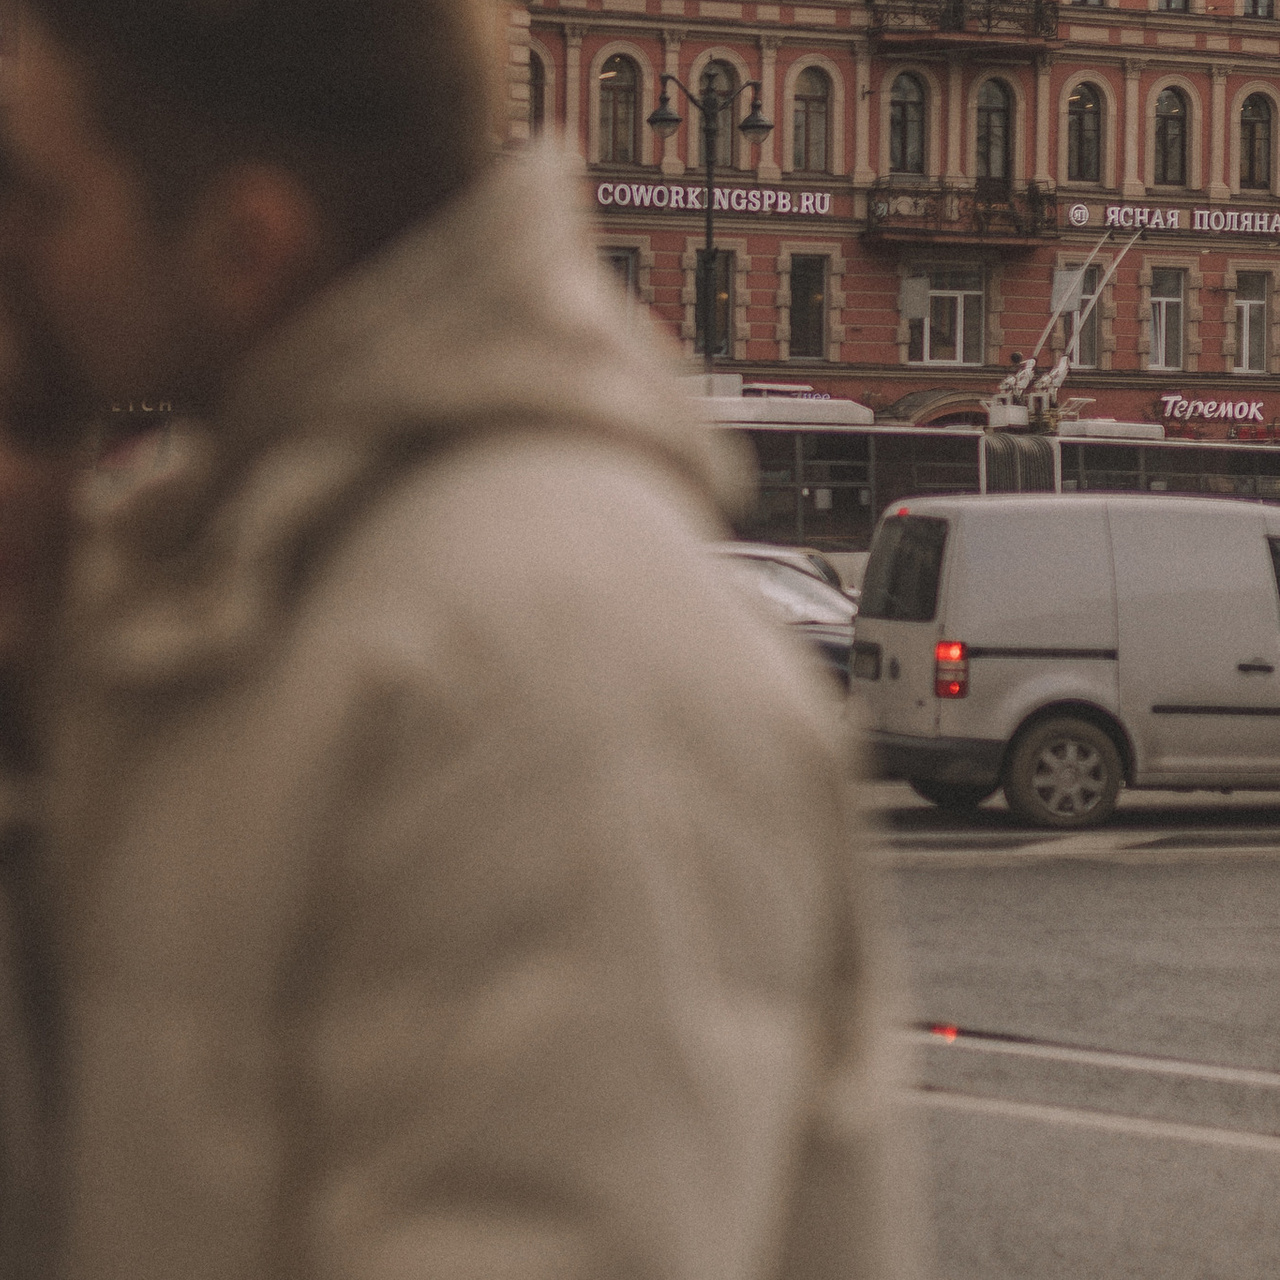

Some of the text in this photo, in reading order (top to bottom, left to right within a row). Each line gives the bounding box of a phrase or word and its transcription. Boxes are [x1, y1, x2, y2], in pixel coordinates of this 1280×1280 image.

[597, 183, 831, 215] COWORKINGSPB.RU
[1105, 206, 1180, 229] ЯСНАЯ
[1193, 210, 1280, 233] ПОЛЯНА
[1161, 395, 1264, 420] Теремок
